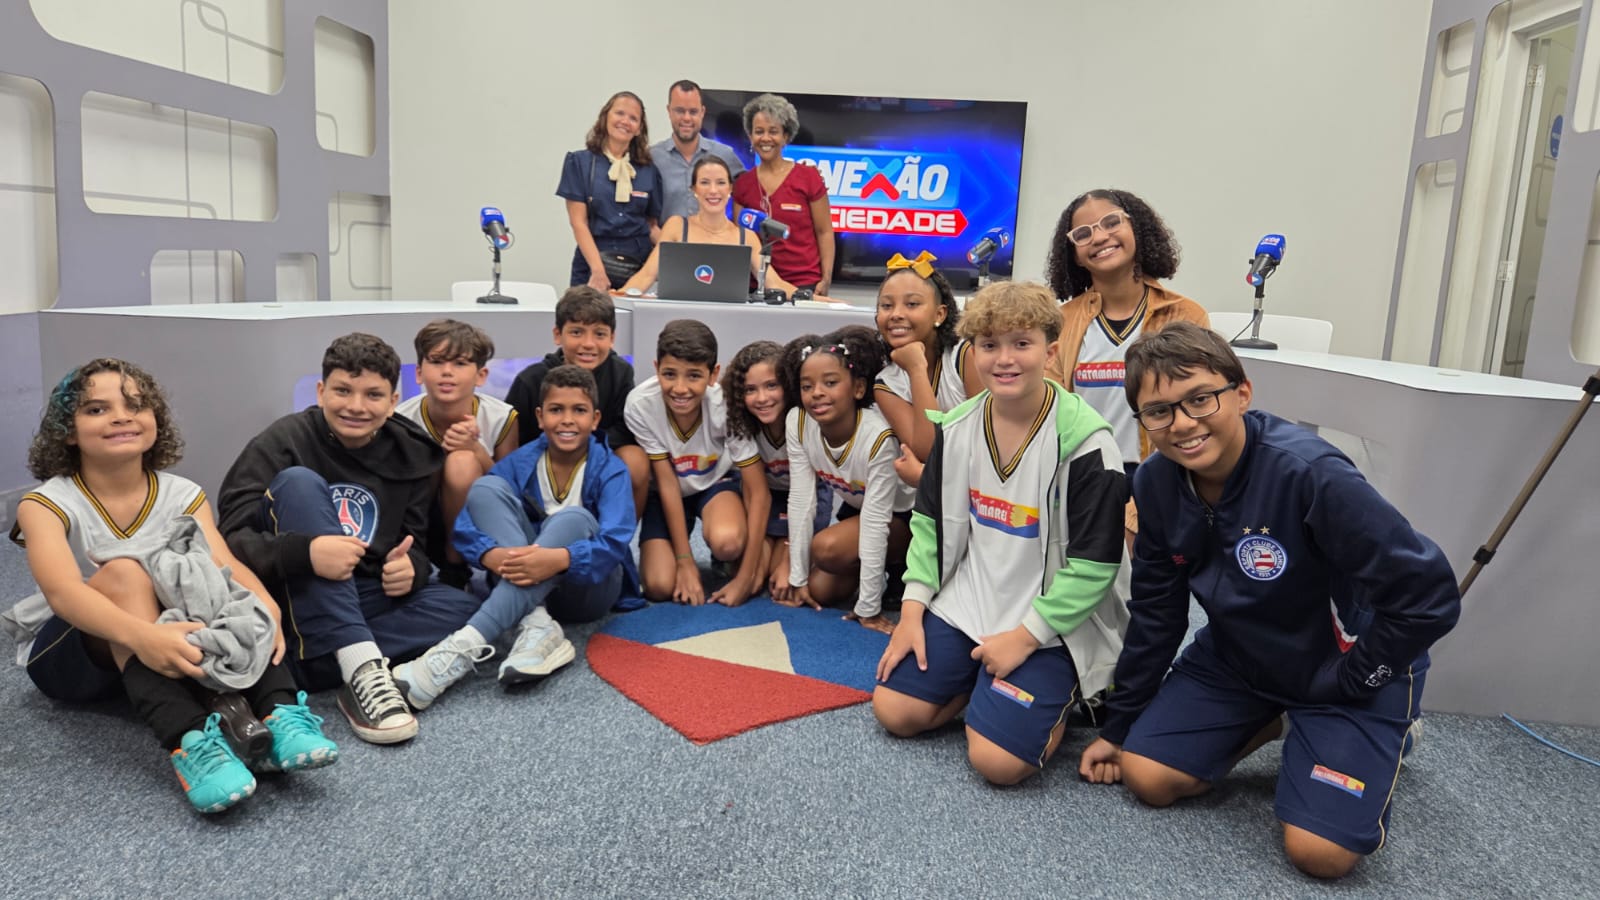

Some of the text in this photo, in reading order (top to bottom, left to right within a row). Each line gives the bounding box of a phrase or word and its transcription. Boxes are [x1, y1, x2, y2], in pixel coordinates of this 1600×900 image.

[783, 156, 949, 201] NEXÃO
[332, 488, 369, 505] ARIS
[1252, 540, 1276, 551] CLUBE
[1275, 549, 1284, 569] BAHIA
